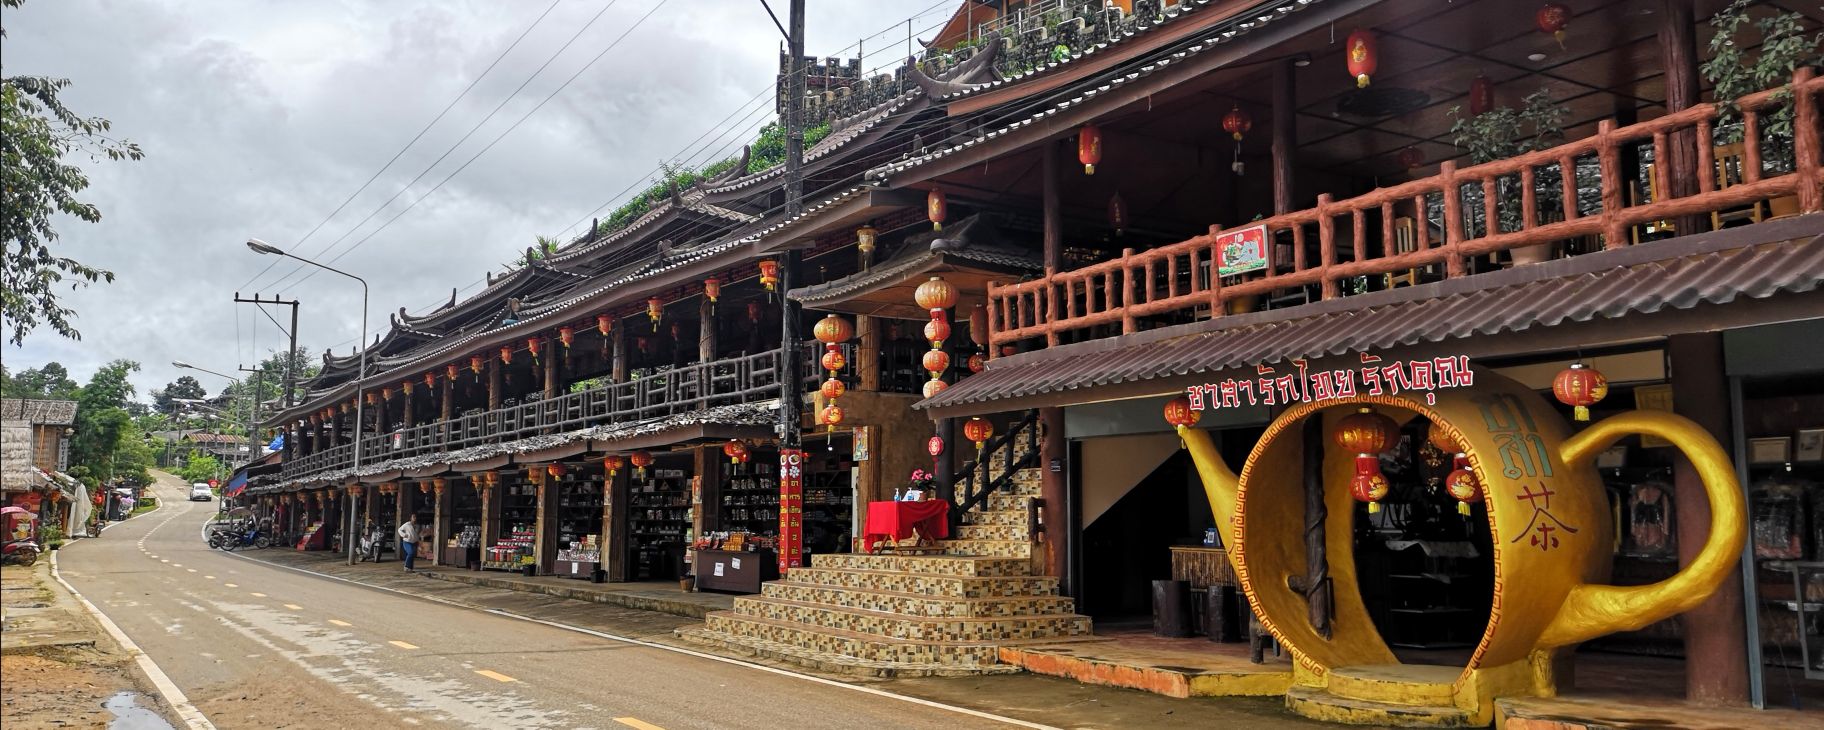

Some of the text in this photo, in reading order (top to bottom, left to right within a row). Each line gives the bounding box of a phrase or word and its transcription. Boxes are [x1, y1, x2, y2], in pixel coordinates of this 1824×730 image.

[1361, 352, 1474, 405] รักคุณ
[1511, 481, 1578, 551] 茶
